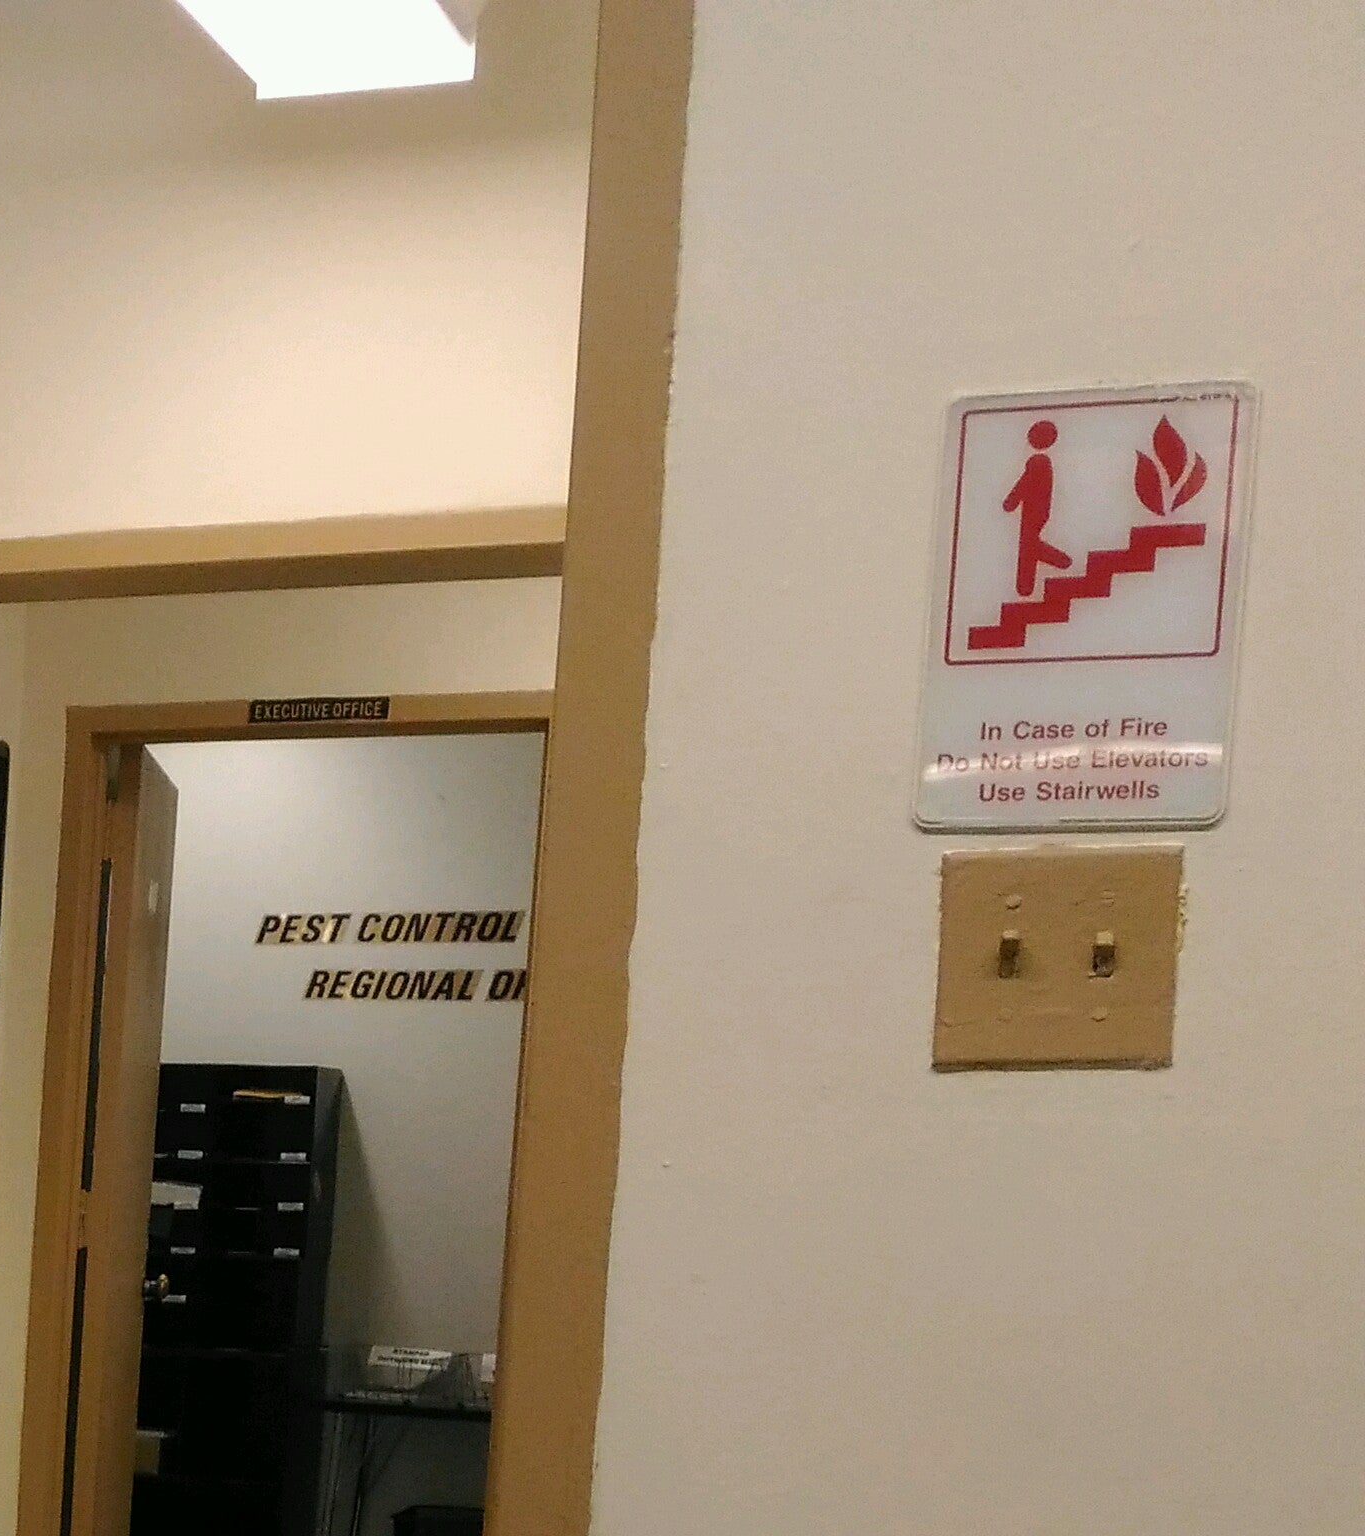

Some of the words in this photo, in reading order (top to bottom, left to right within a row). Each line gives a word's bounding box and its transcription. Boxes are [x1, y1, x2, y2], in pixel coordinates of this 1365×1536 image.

[254, 703, 329, 719] EXECUTIVE
[332, 701, 382, 717] OFFICE
[980, 722, 1002, 740] In
[1013, 721, 1075, 739] Case
[1085, 718, 1110, 738] of
[1120, 717, 1168, 737] Fire
[937, 754, 968, 772] Do
[980, 752, 1023, 771] Not
[1034, 750, 1081, 769] Use
[1091, 749, 1209, 768] Elevators
[978, 783, 1026, 801] Use
[1036, 780, 1160, 800] Stairwells
[255, 912, 351, 944] PEST
[357, 911, 519, 943] CONTROL
[304, 969, 474, 1000] REGIONAL
